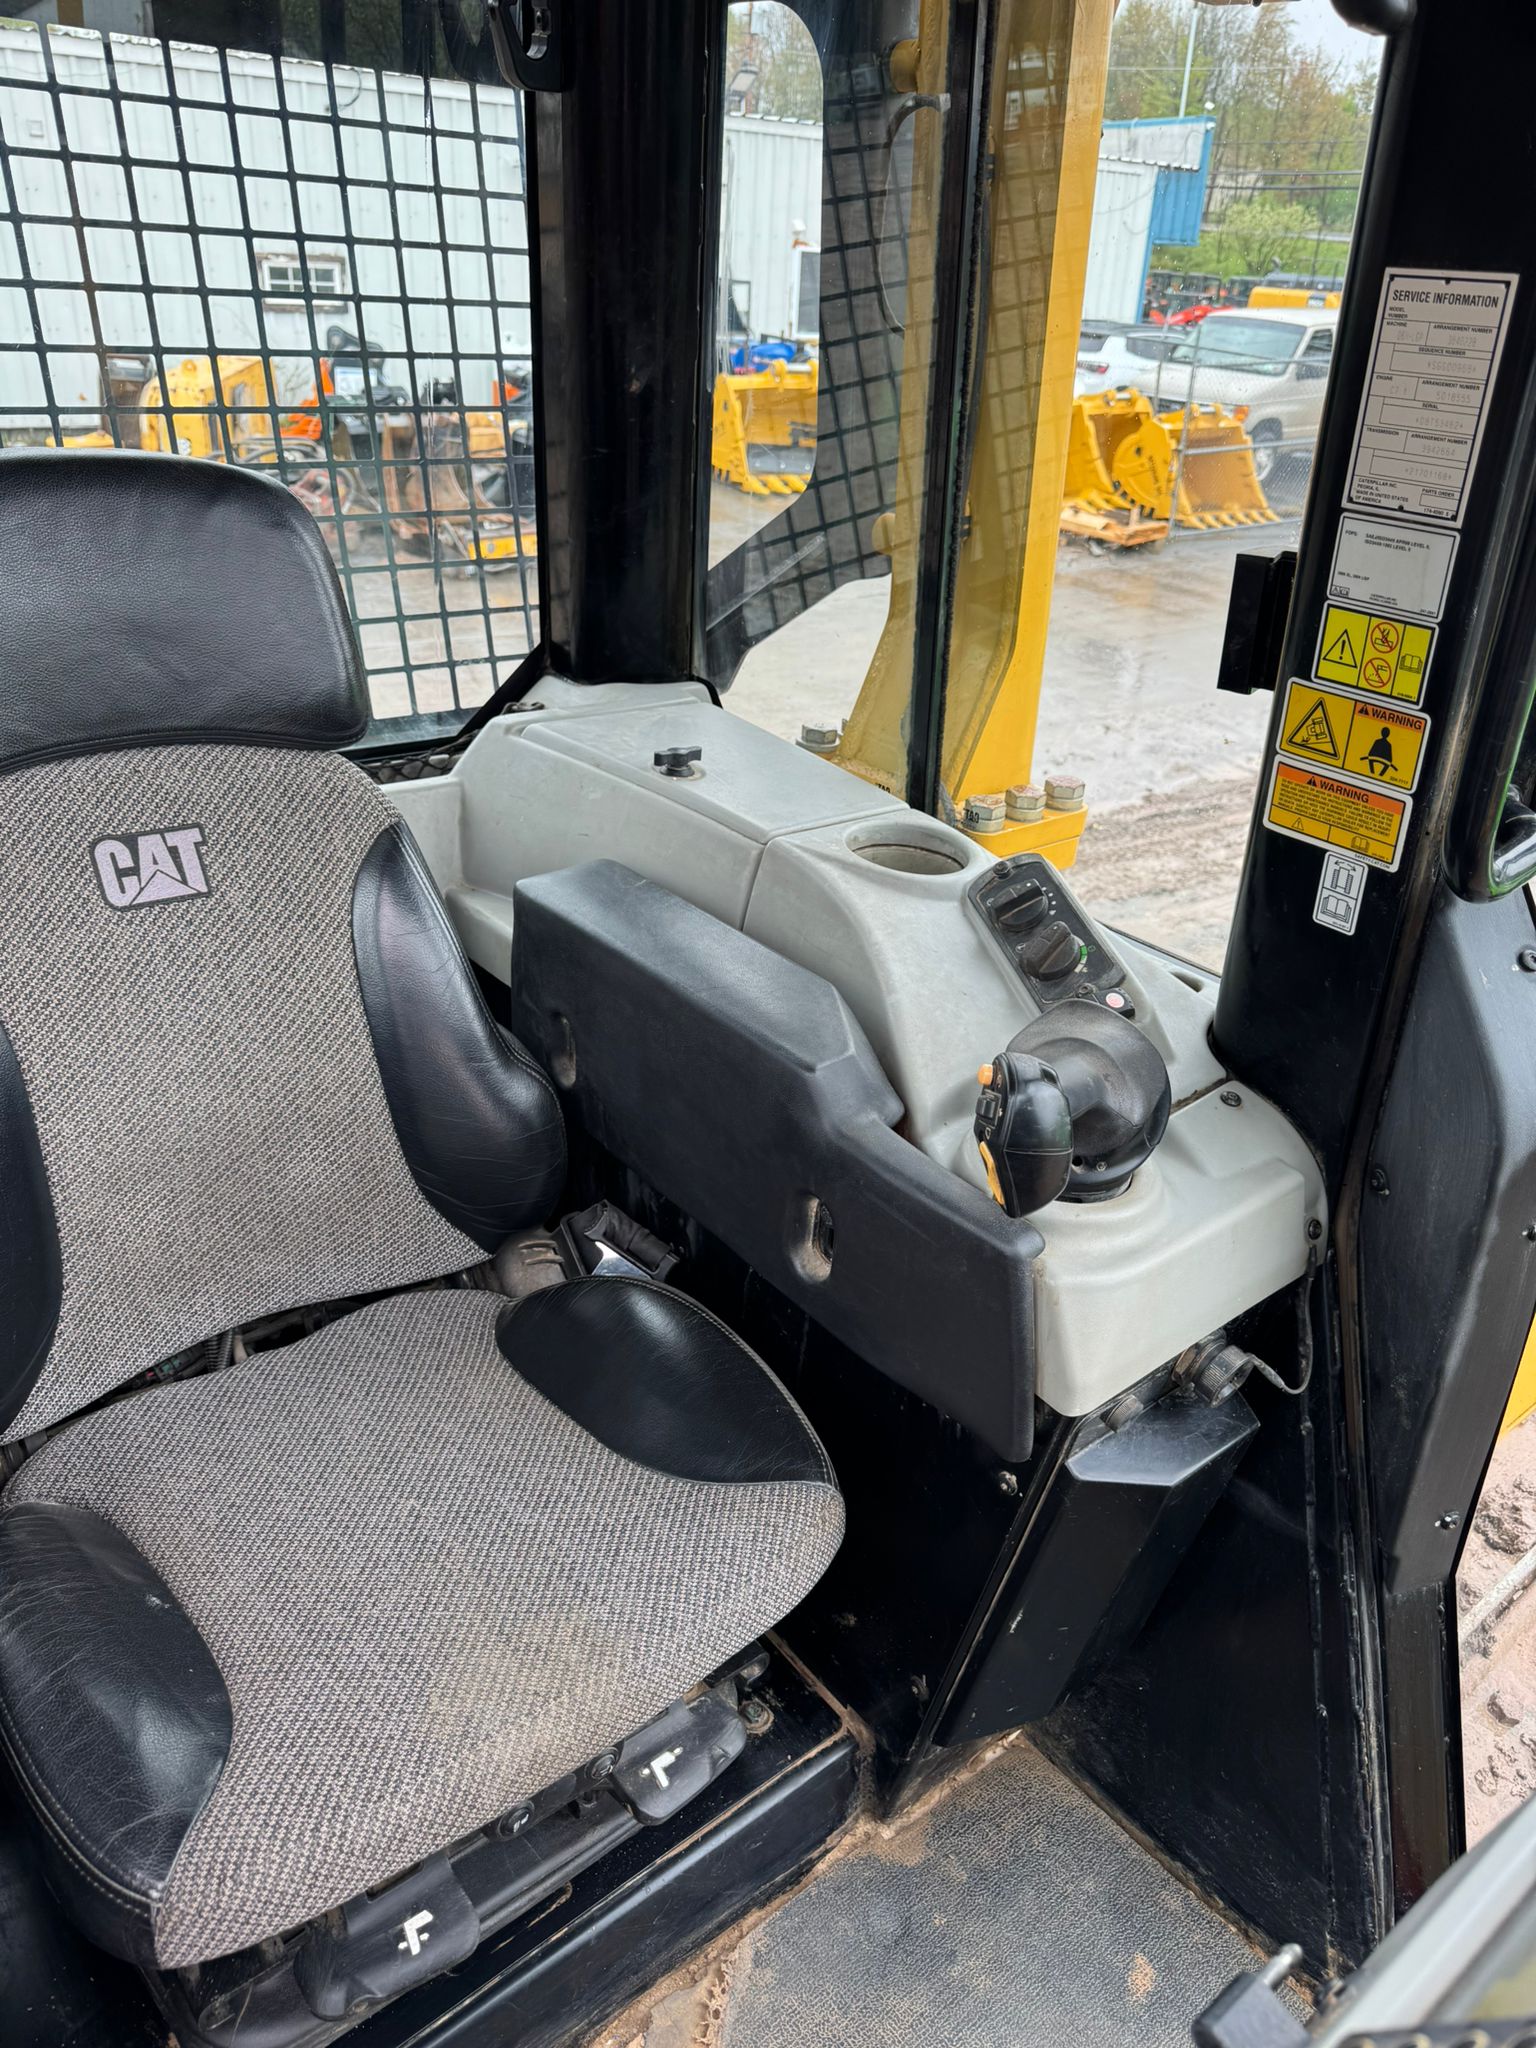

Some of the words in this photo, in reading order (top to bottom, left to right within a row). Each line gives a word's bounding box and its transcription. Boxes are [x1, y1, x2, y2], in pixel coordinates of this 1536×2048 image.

[1392, 289, 1431, 303] SERVICE
[1433, 292, 1500, 307] INFORMATION
[1422, 379, 1457, 388] ARRANGEMENT
[1411, 432, 1446, 442] ARRANGEMENT
[1359, 477, 1388, 486] CATERPILLAR
[1375, 491, 1390, 499] UNITED
[1391, 494, 1408, 502] STATES
[1372, 708, 1423, 730] WARNING
[1320, 780, 1369, 804] WARNING
[94, 828, 209, 907] CAT
